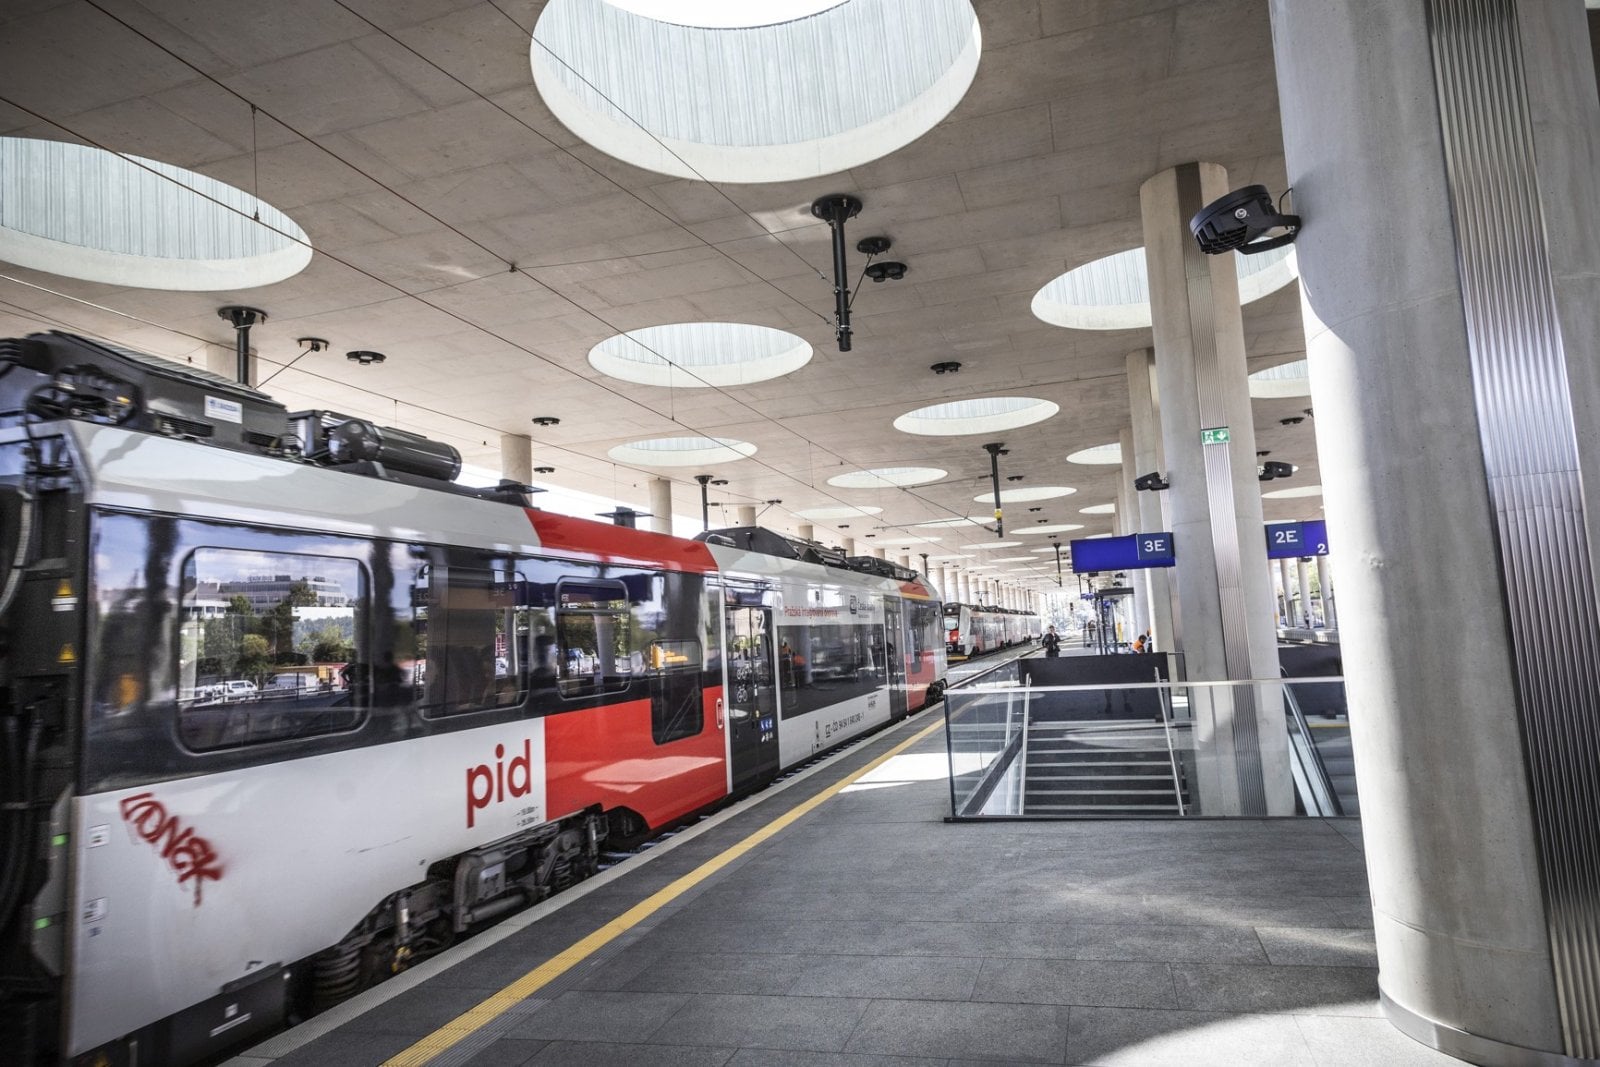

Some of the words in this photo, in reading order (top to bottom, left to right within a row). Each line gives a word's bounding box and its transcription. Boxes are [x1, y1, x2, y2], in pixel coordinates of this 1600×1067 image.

[1275, 530, 1299, 544] 2E
[1144, 539, 1166, 552] 3E
[1317, 543, 1327, 554] 2
[466, 738, 532, 828] pid
